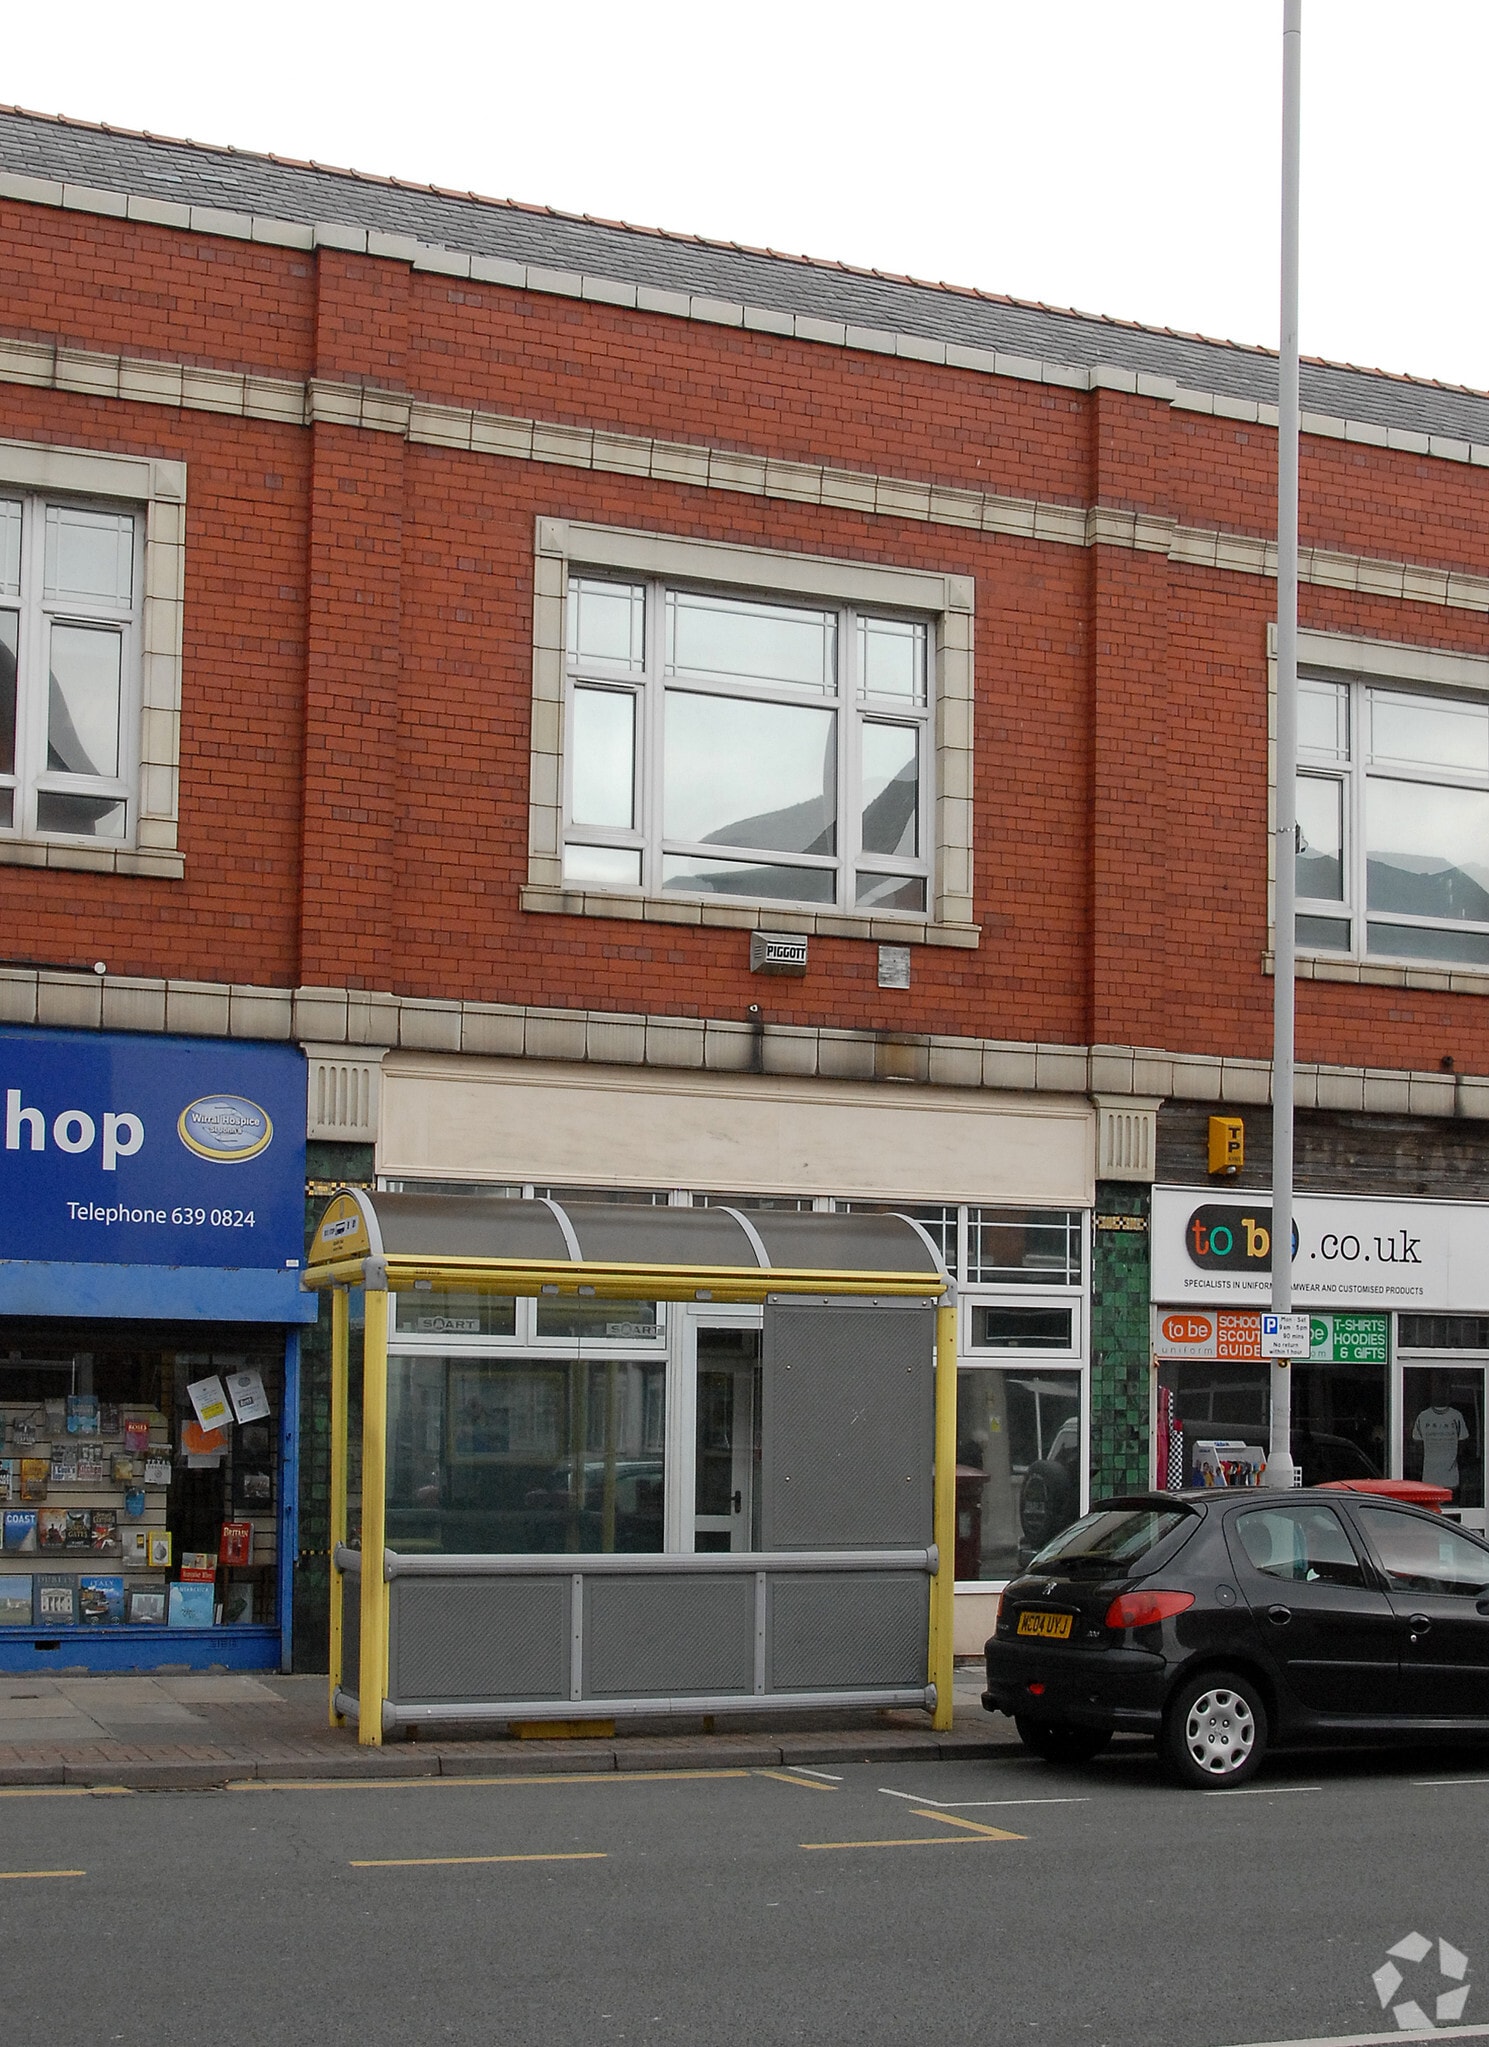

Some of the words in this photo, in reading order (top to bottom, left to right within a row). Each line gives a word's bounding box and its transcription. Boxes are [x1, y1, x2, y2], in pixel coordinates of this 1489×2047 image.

[767, 945, 806, 960] PIGGOTT
[192, 1113, 220, 1125] Wirral
[222, 1115, 261, 1128] Hospice
[67, 1202, 167, 1225] Telephone
[171, 1207, 206, 1226] 639
[210, 1209, 256, 1228] 0824
[1192, 1219, 1233, 1256] to
[1311, 1230, 1422, 1264] .co.uk
[1184, 1279, 1231, 1290] SPECIALISTS
[1233, 1280, 1240, 1289] IN
[1322, 1283, 1337, 1293] AND
[1338, 1284, 1384, 1294] CUSTOMISED
[1385, 1286, 1424, 1296] PRODUCTS
[1168, 1320, 1184, 1339] to
[1188, 1320, 1208, 1337] be
[1334, 1319, 1386, 1332] T-SHIRTS
[1334, 1333, 1386, 1346] HOODIES
[1162, 1345, 1213, 1355] uniform
[1340, 1347, 1349, 1359] &
[1354, 1347, 1386, 1360] GIFTS
[6, 1514, 36, 1524] COAST
